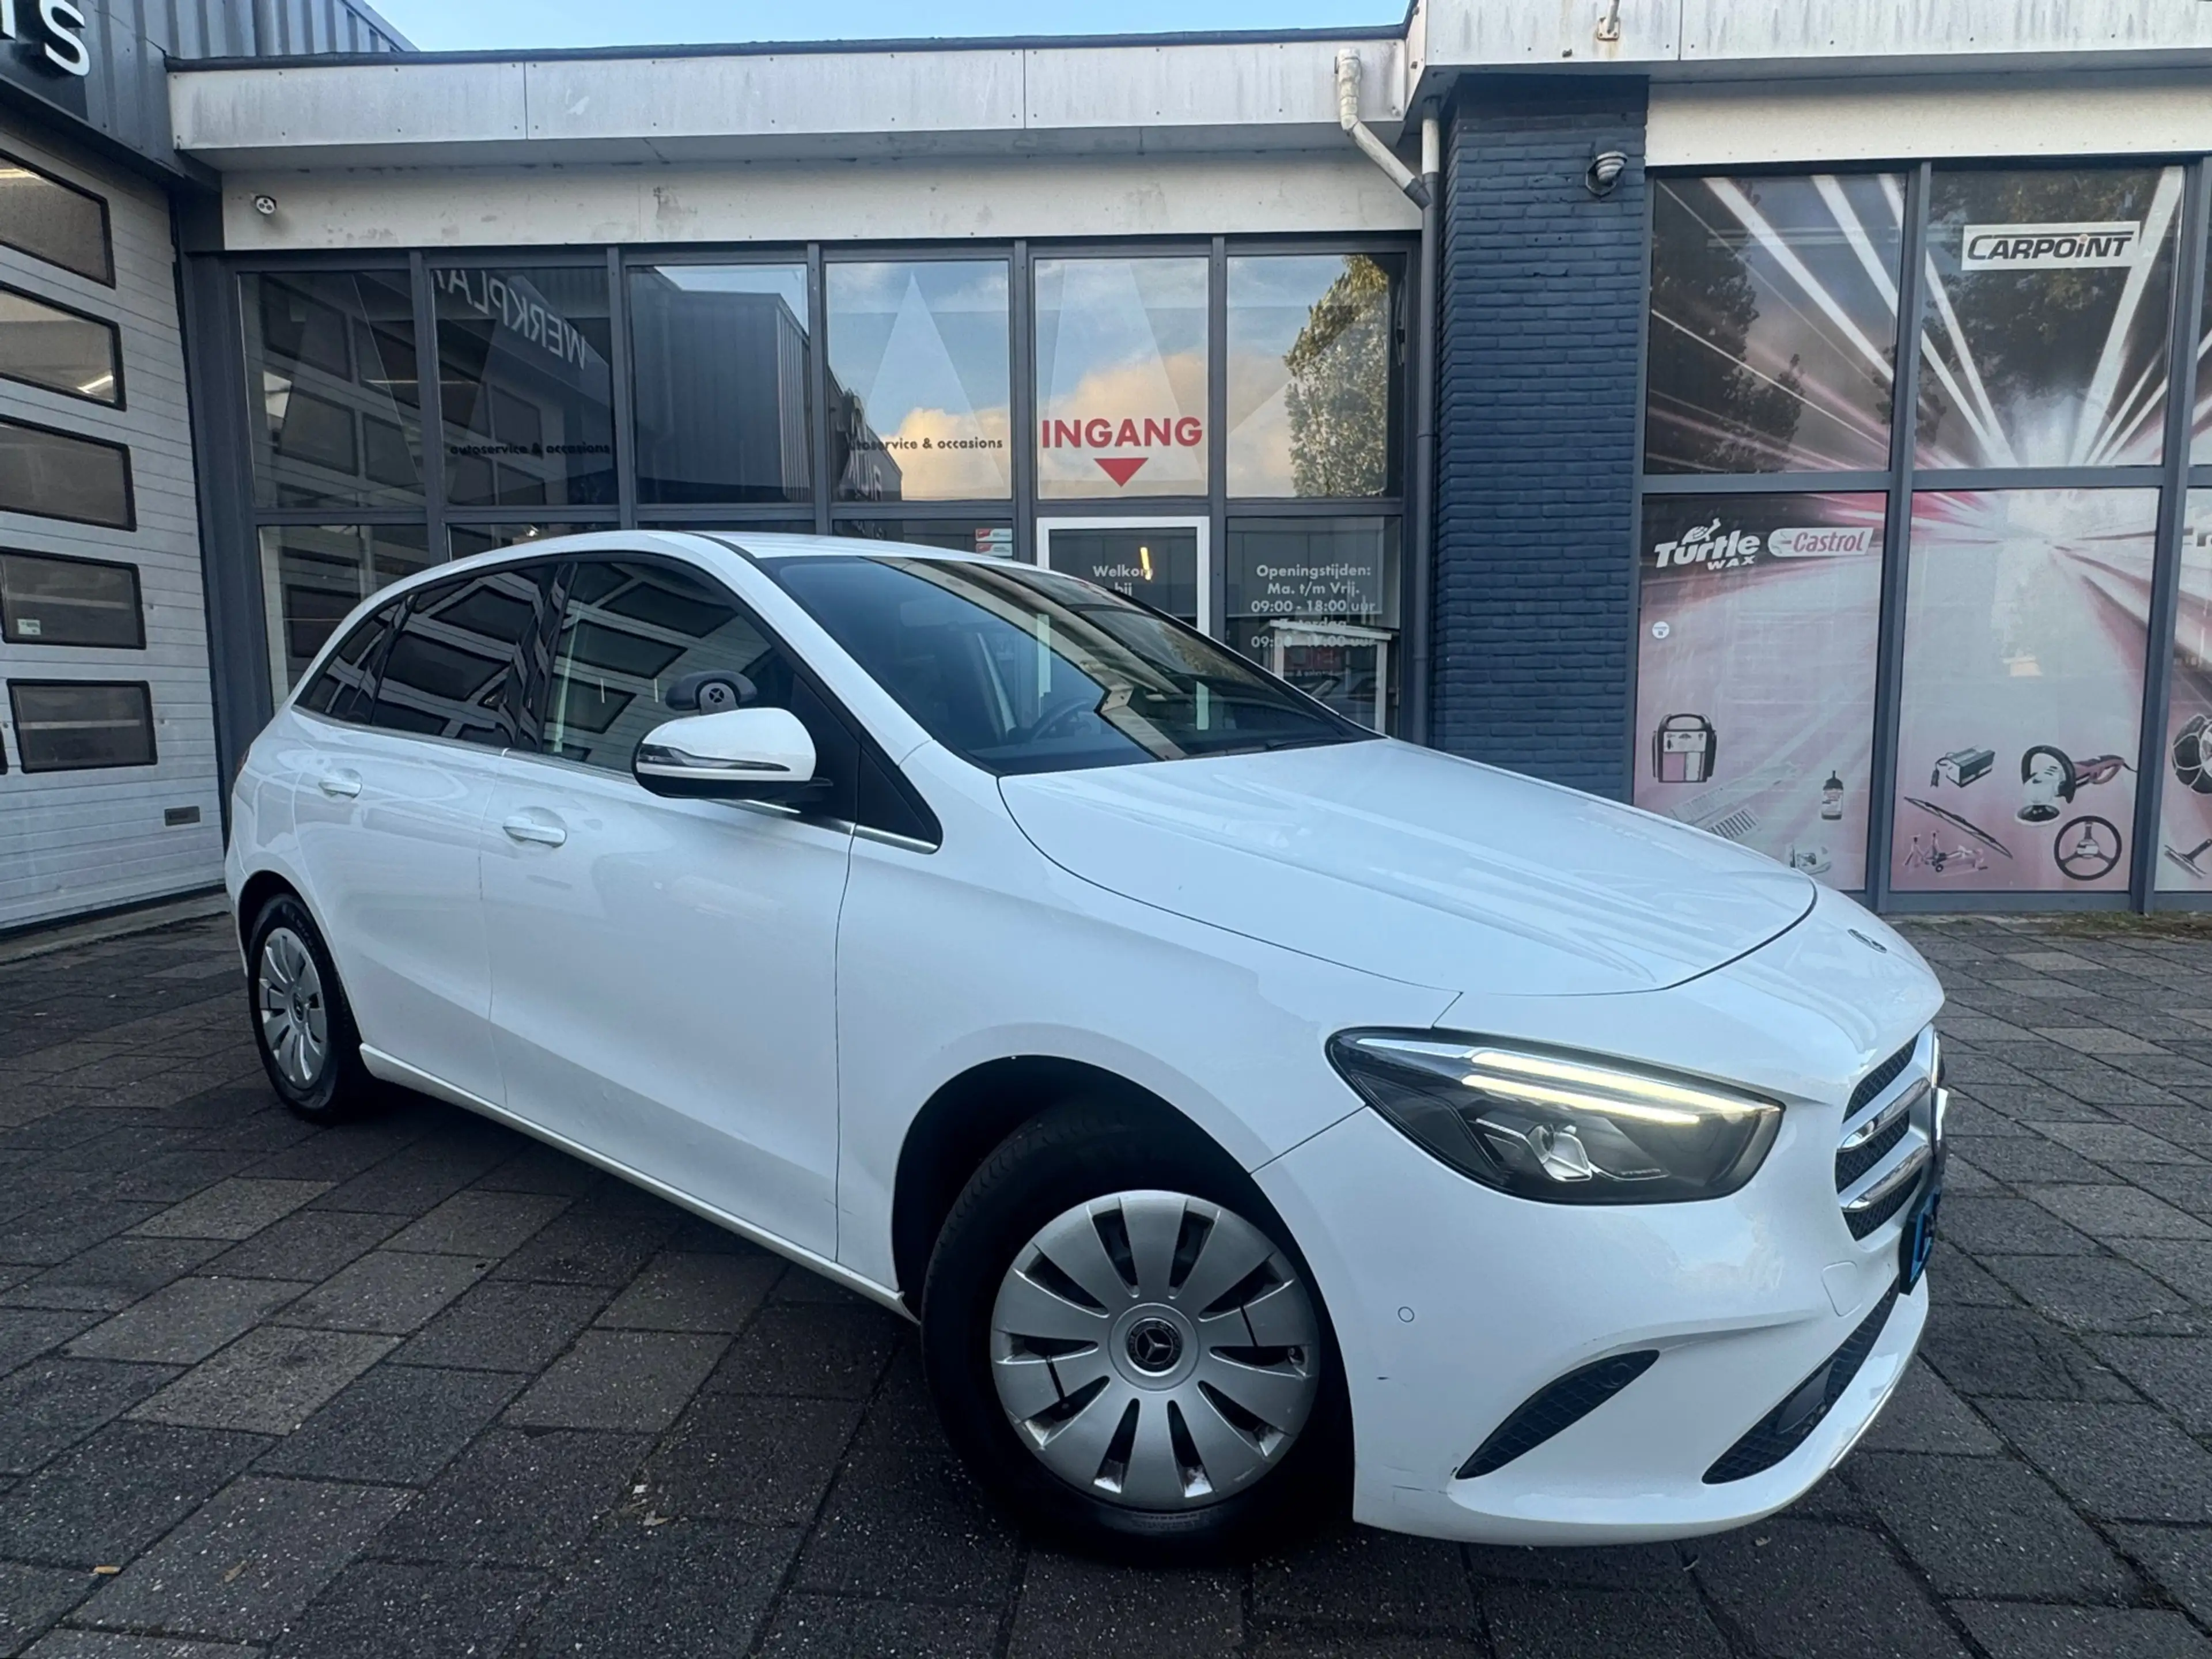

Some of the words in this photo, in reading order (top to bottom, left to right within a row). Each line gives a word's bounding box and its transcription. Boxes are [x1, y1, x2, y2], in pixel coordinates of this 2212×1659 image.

[1042, 416, 1203, 448] INGANG
[450, 443, 529, 454] autoservice
[546, 441, 610, 454] occasions
[922, 438, 932, 449] &
[937, 437, 1002, 449] occasions
[1654, 530, 1760, 569] Turtle
[1707, 555, 1756, 571] WAX
[1794, 532, 1865, 554] Castrol
[1256, 563, 1371, 580] Openingstijden:
[1267, 582, 1295, 594] Ma.
[1300, 581, 1325, 596] t/m
[1330, 581, 1360, 597] Vrij.
[1251, 600, 1293, 612] 09:00
[1307, 600, 1346, 612] 18:00
[1351, 602, 1376, 612] uur
[1251, 635, 1293, 647] 09:00
